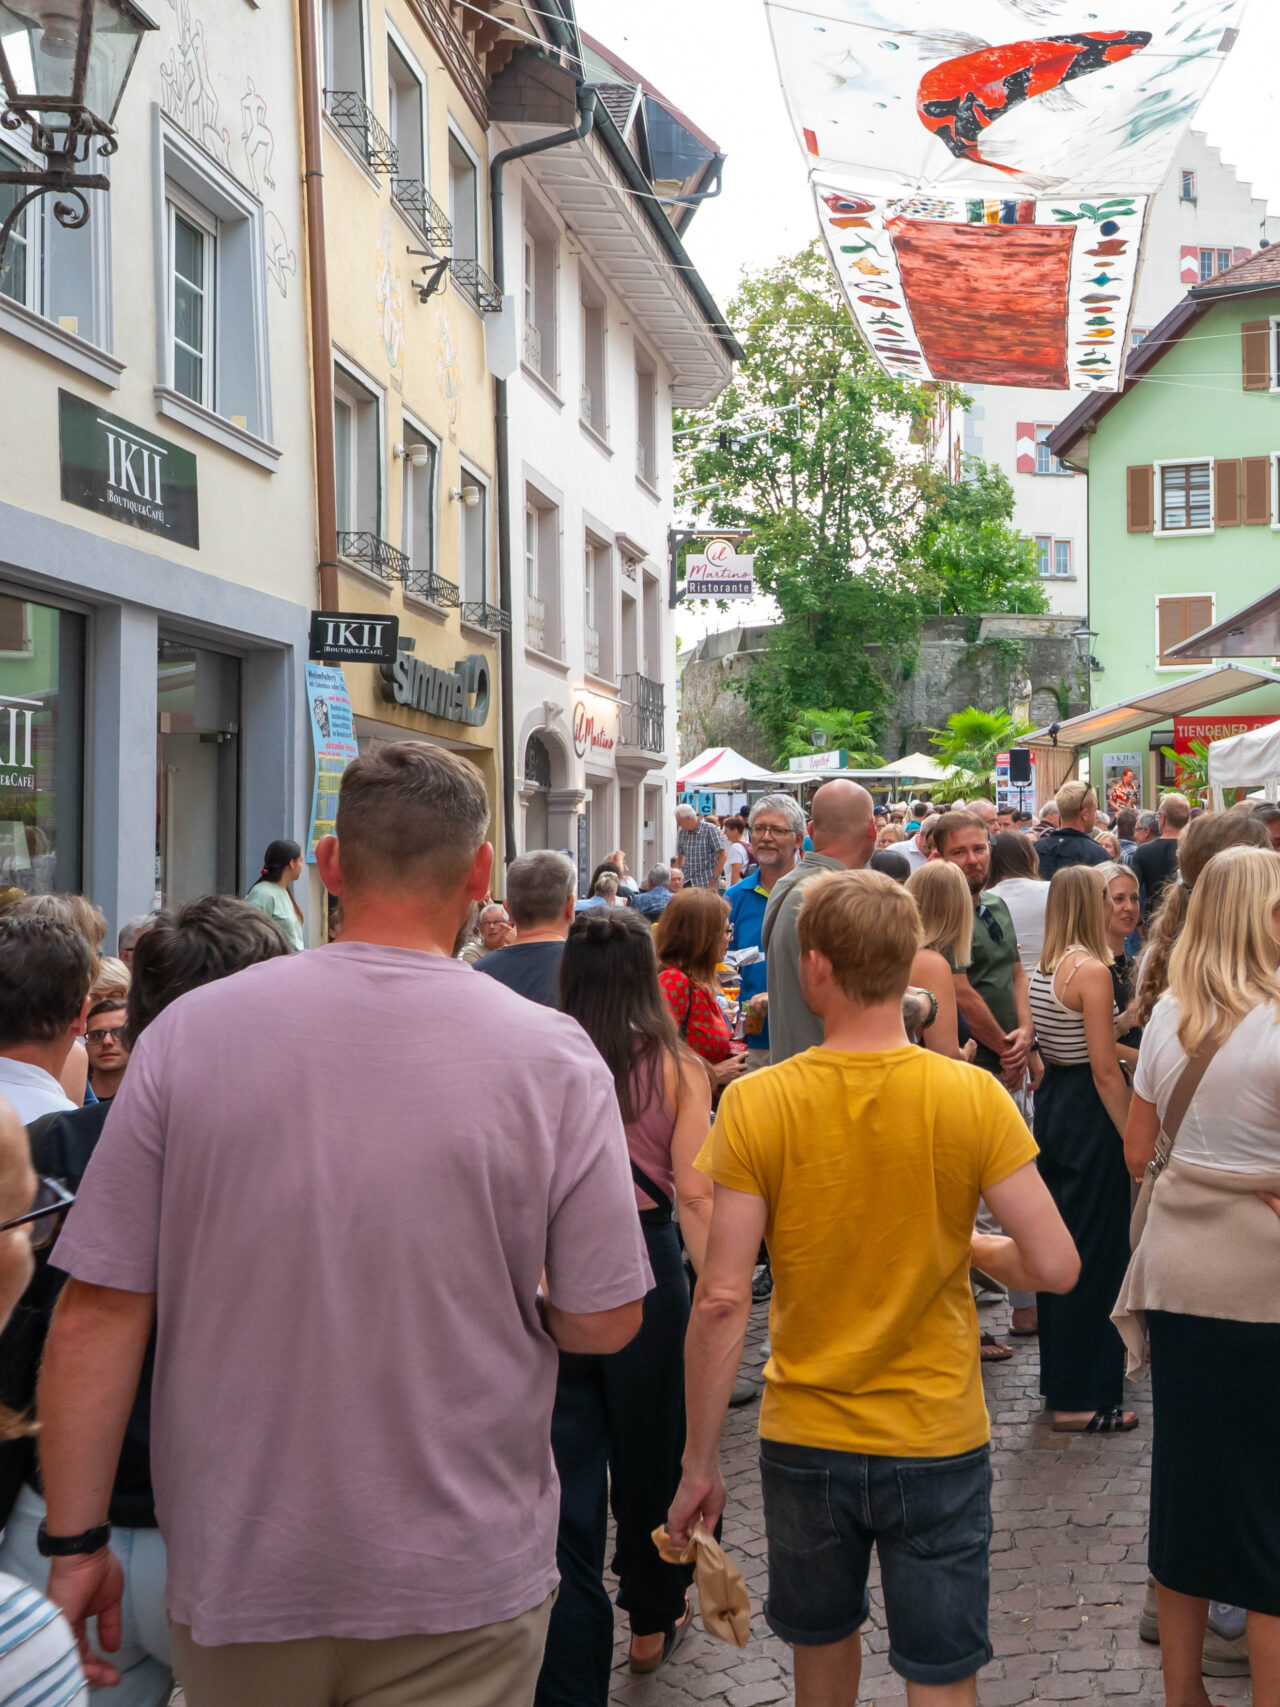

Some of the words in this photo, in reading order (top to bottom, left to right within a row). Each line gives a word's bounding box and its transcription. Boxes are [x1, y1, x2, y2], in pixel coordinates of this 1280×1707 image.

[106, 432, 164, 506] IKII
[689, 564, 751, 581] Martino
[689, 582, 750, 593] Ristorante
[324, 622, 384, 648] IKII
[0, 705, 35, 768] II
